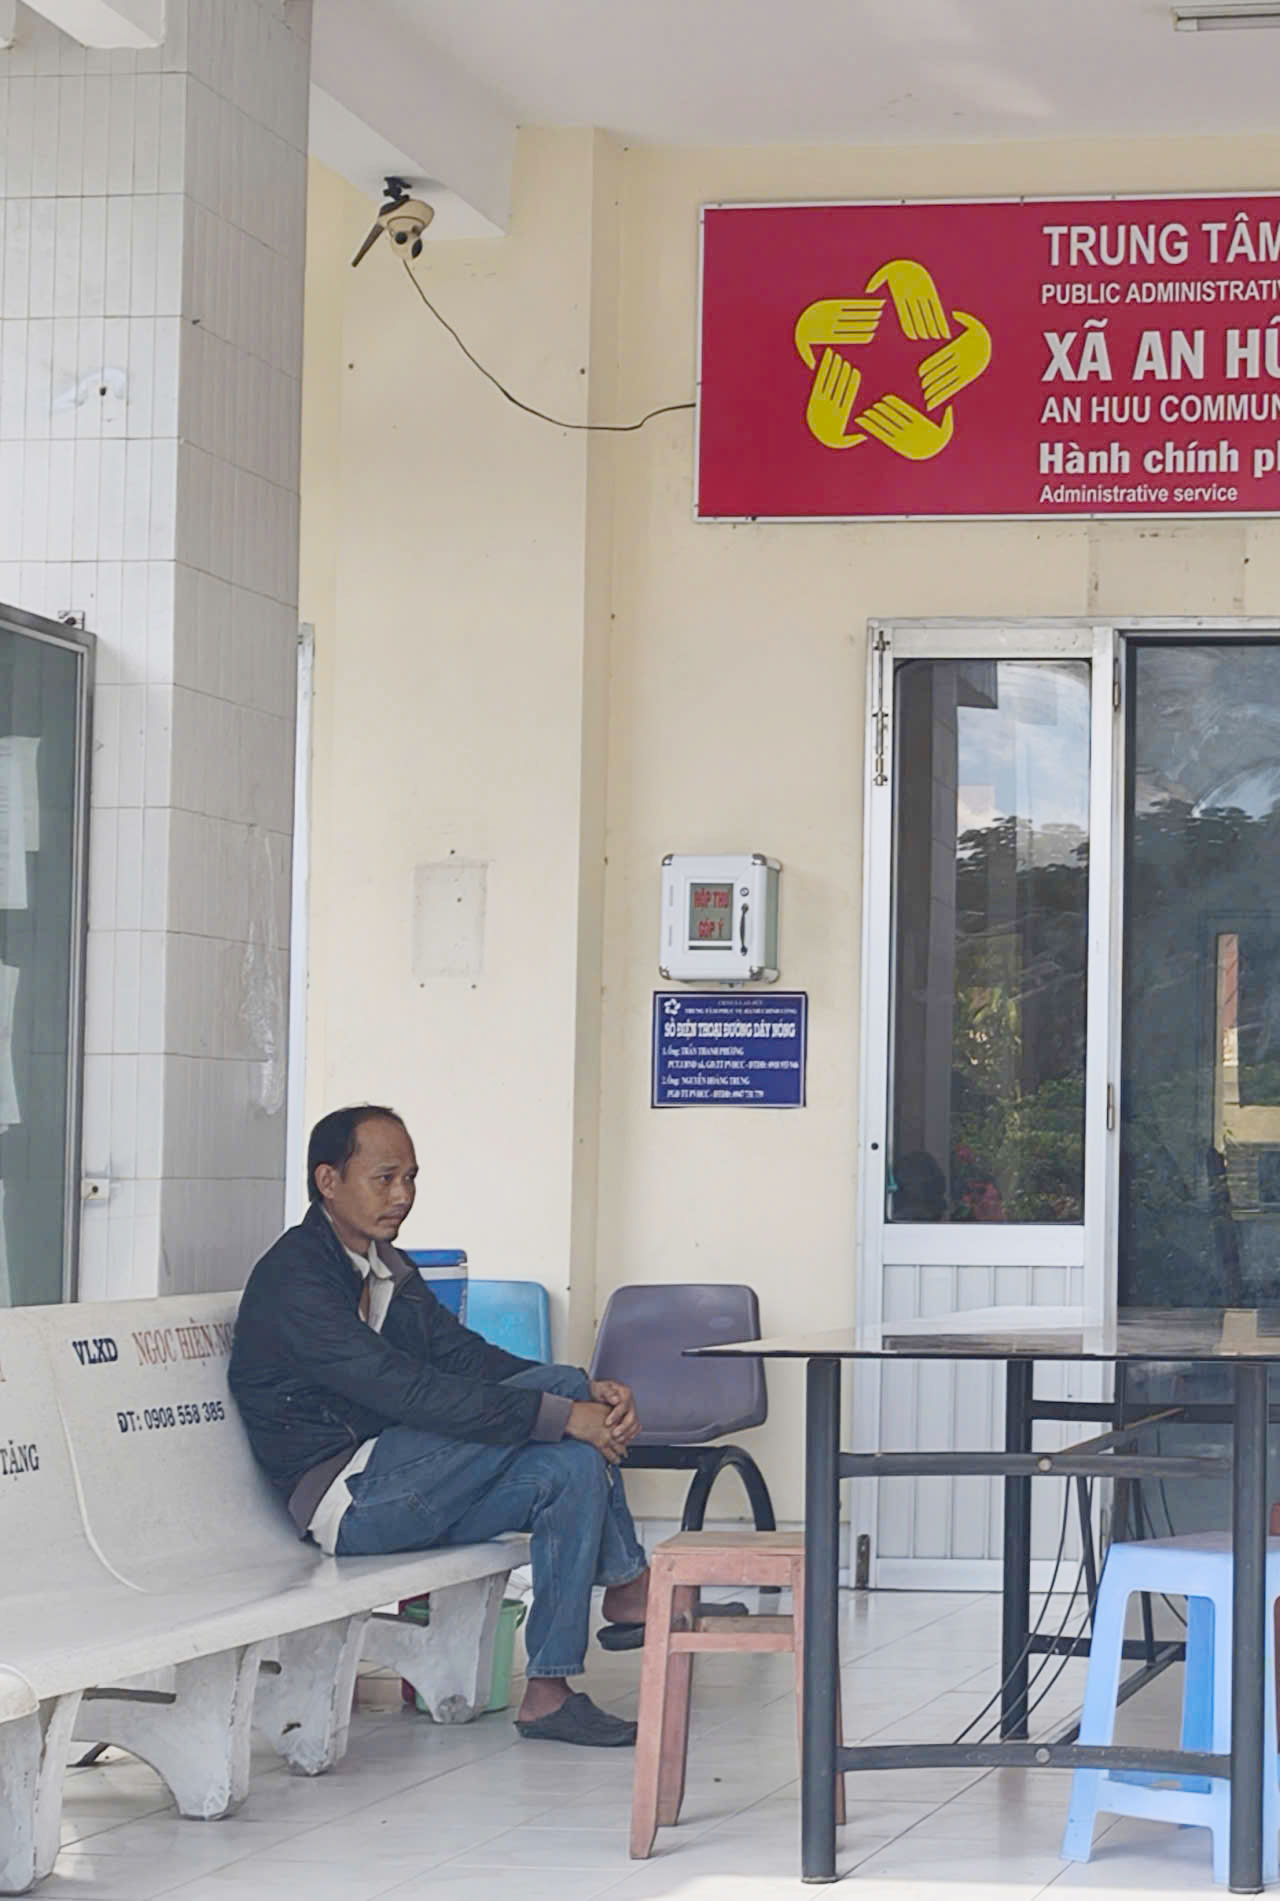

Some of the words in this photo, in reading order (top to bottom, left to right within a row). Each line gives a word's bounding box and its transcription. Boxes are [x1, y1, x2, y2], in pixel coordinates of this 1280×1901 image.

[1043, 224, 1188, 265] TRUNG
[1042, 283, 1120, 304] PUBLIC
[1042, 318, 1112, 381] XÃ
[1133, 330, 1204, 380] AN
[1041, 397, 1081, 423] AN
[1091, 396, 1150, 422] HUU
[1040, 442, 1130, 474] Hành
[1144, 441, 1238, 473] chính
[1040, 485, 1168, 503] Administrative
[1173, 484, 1238, 502] service
[72, 1337, 118, 1365] VLXD
[132, 1329, 177, 1371] NGỌC
[117, 1411, 143, 1432] ĐT:
[144, 1407, 175, 1430] 0908
[177, 1404, 200, 1426] 558
[202, 1400, 225, 1422] 385
